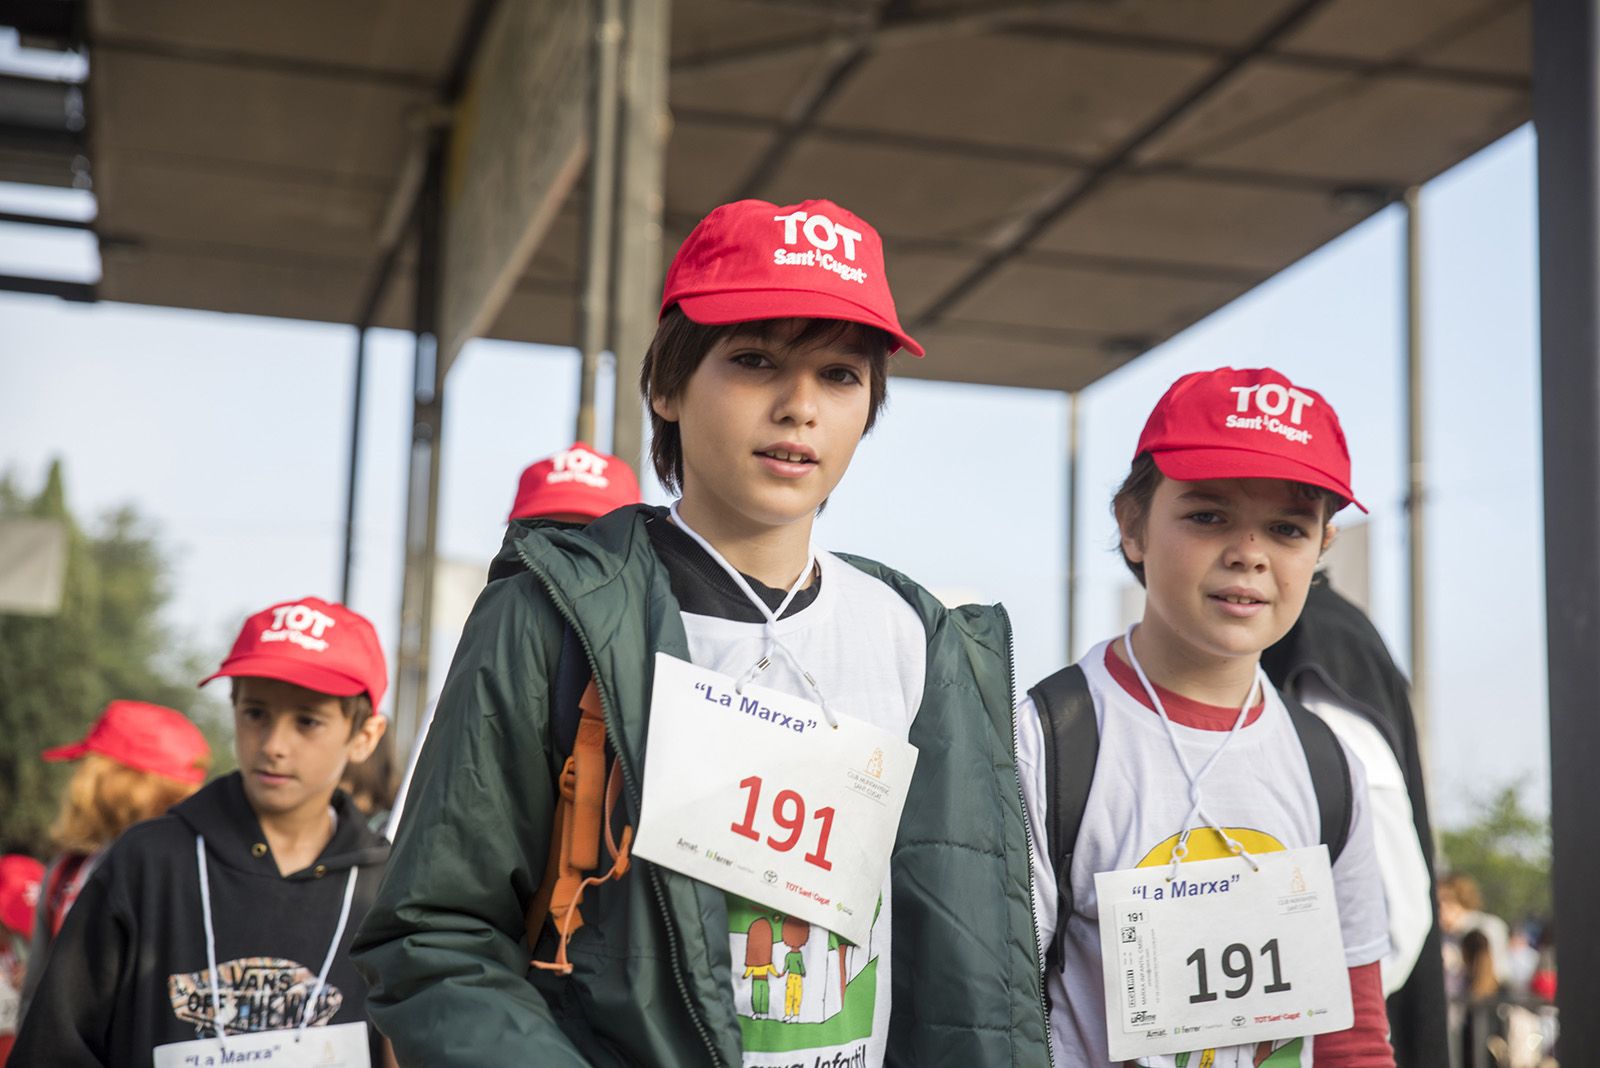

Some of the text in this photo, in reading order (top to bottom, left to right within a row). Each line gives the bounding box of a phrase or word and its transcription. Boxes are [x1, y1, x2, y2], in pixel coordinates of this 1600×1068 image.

[773, 211, 863, 261] TOT
[773, 248, 866, 284] Sant Cugat
[1229, 383, 1315, 425] TOT
[1225, 414, 1309, 445] Sant Cugat
[551, 449, 609, 476] TOT
[272, 604, 336, 638] TOT
[730, 776, 836, 872] 191
[1127, 912, 1144, 922] 191
[230, 964, 292, 993] VANS
[1186, 938, 1292, 1004] 191
